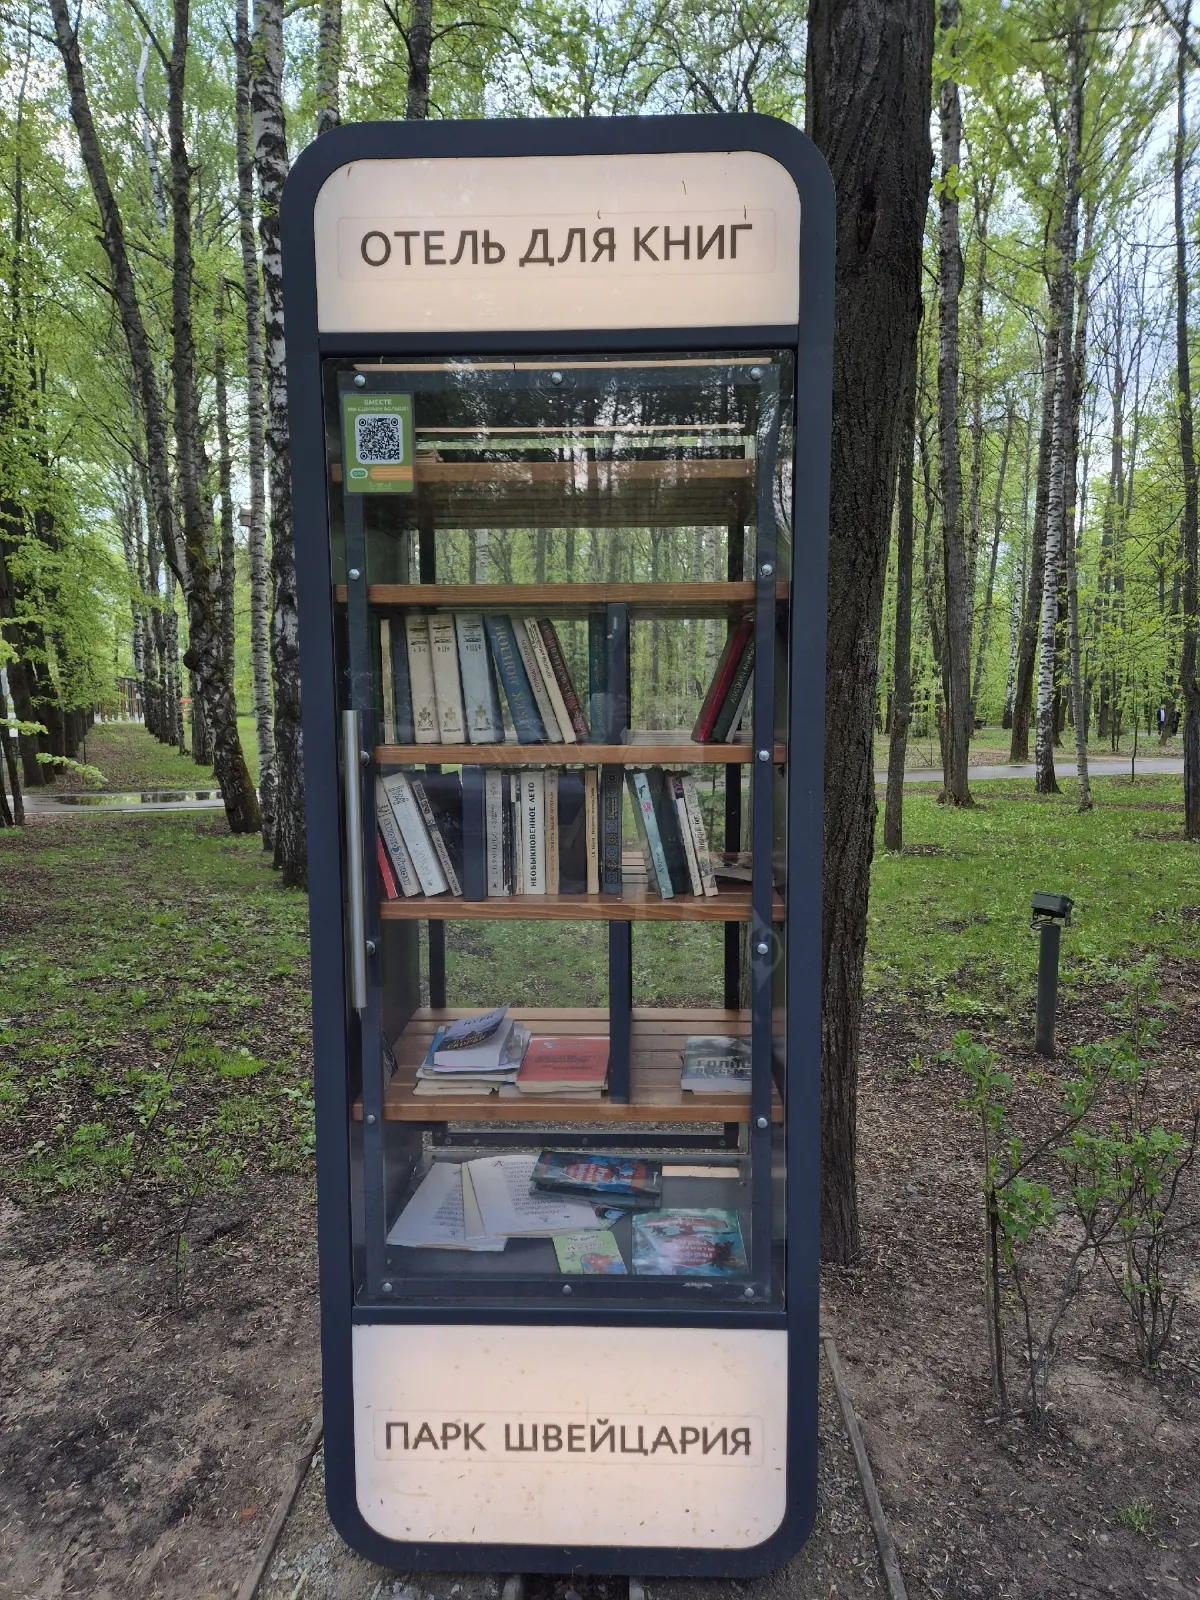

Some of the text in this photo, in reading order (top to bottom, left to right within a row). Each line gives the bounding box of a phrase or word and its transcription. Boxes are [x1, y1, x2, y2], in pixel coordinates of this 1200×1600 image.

[361, 223, 753, 267] ОТЕЛЬ ДЛЯ КНИГ
[527, 782, 537, 887] НЕОБЫКНОВЕННОЕ ЛЕТО
[385, 1418, 752, 1456] ПАРК ШВЕЙЦАРИЯ
